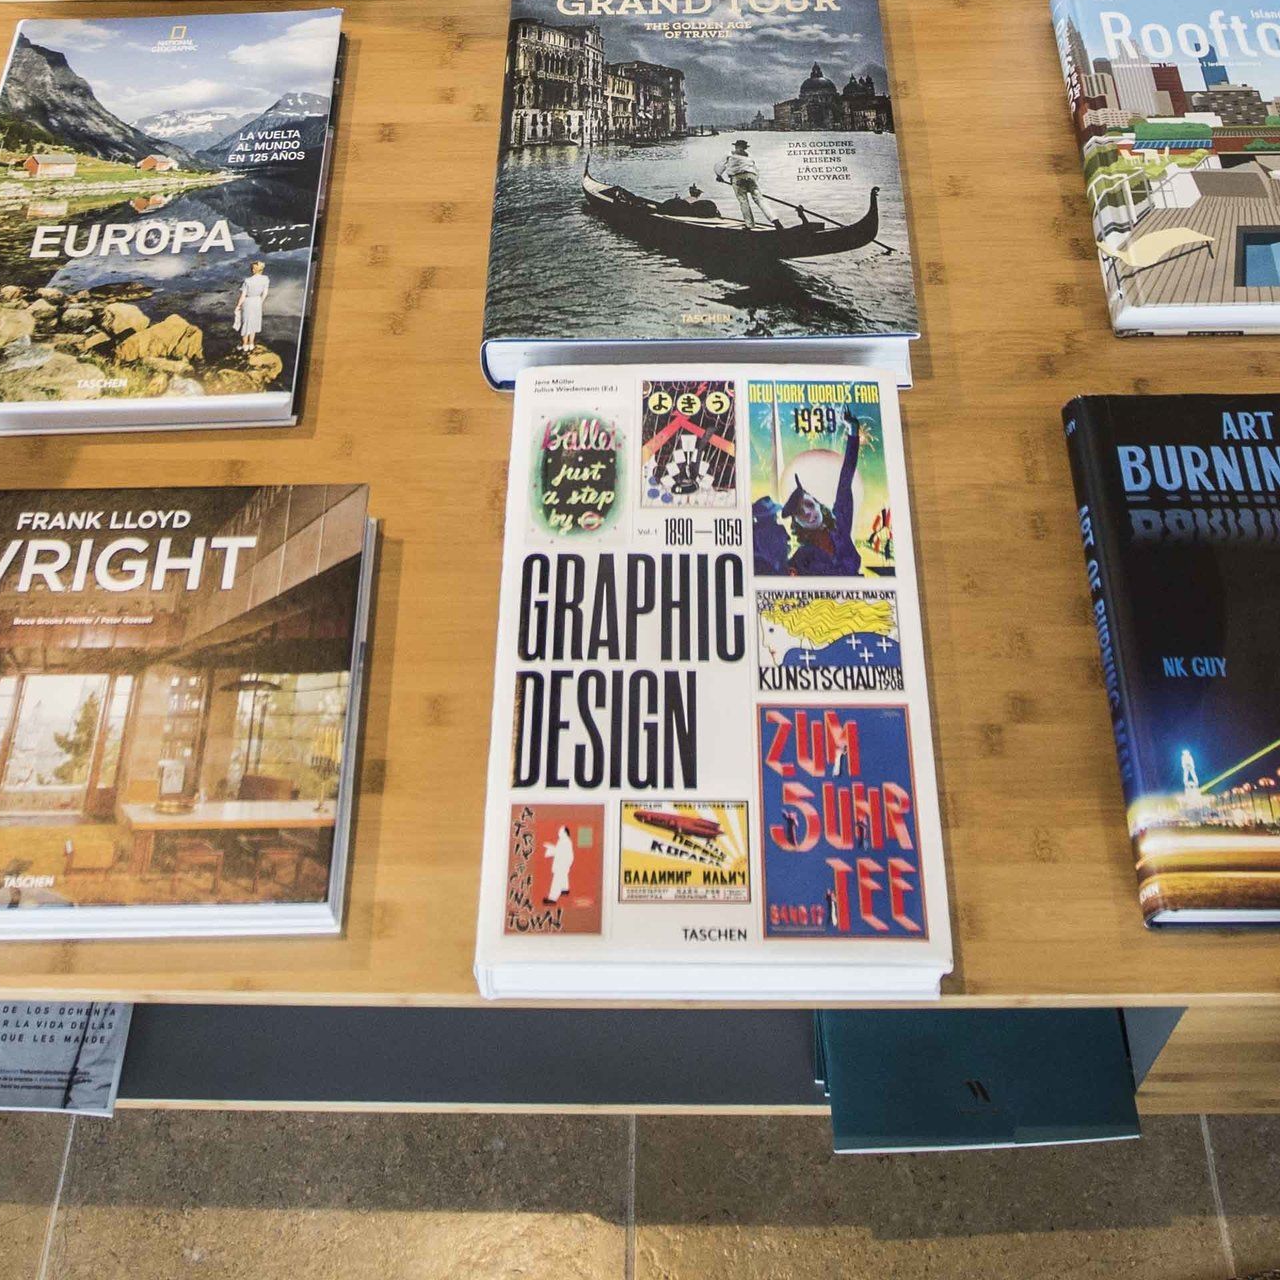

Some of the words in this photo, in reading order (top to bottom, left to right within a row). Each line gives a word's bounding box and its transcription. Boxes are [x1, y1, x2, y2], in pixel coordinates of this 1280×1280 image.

[644, 22, 669, 31] THE
[672, 22, 724, 30] GOLDEN
[726, 21, 752, 29] AGE
[665, 30, 681, 39] OF
[681, 30, 730, 38] TRAVEL
[239, 131, 254, 140] LA
[257, 130, 301, 140] VUELTA
[236, 143, 251, 152] AL
[254, 140, 300, 151] MUNDO
[228, 154, 246, 163] EN
[249, 153, 268, 162] 125
[268, 150, 305, 161] AÑOS
[29, 219, 235, 258] EUROPA
[680, 314, 731, 324] TASCHEN
[76, 378, 128, 388] TASCHEN
[749, 383, 772, 403] NEW
[776, 384, 806, 403] YORK
[807, 384, 853, 403] WORLD'S
[855, 385, 879, 403] FAIR
[794, 407, 837, 434] 1939
[1221, 411, 1274, 441] ART
[551, 461, 606, 486] just
[543, 490, 559, 505] a
[566, 486, 615, 510] step
[16, 511, 104, 530] FRANK
[109, 510, 191, 530] LLOYD
[549, 509, 575, 535] by
[519, 552, 746, 662] GRAPHIC
[877, 667, 903, 679] WIEN
[1163, 656, 1189, 678] NK
[1192, 656, 1227, 678] GUY
[759, 666, 877, 691] KUNSTSCHAU
[879, 679, 904, 690] 1908
[512, 669, 698, 789] DESIGN
[766, 708, 860, 777] ZUM
[522, 806, 533, 820] A
[3, 875, 55, 888] TASCHEN
[703, 870, 746, 885] ИЛЬИЧ
[825, 857, 921, 932] TEE
[682, 928, 747, 942] TASCHEN
[3, 1005, 17, 1014] DE
[27, 1006, 49, 1015] LOS
[59, 1006, 116, 1016] OCHENTA
[16, 1019, 29, 1028] LA
[36, 1020, 63, 1029] VIDA
[71, 1021, 85, 1030] DE
[92, 1021, 113, 1030] LAS
[1, 1033, 23, 1042] QUE
[33, 1034, 55, 1043] LES
